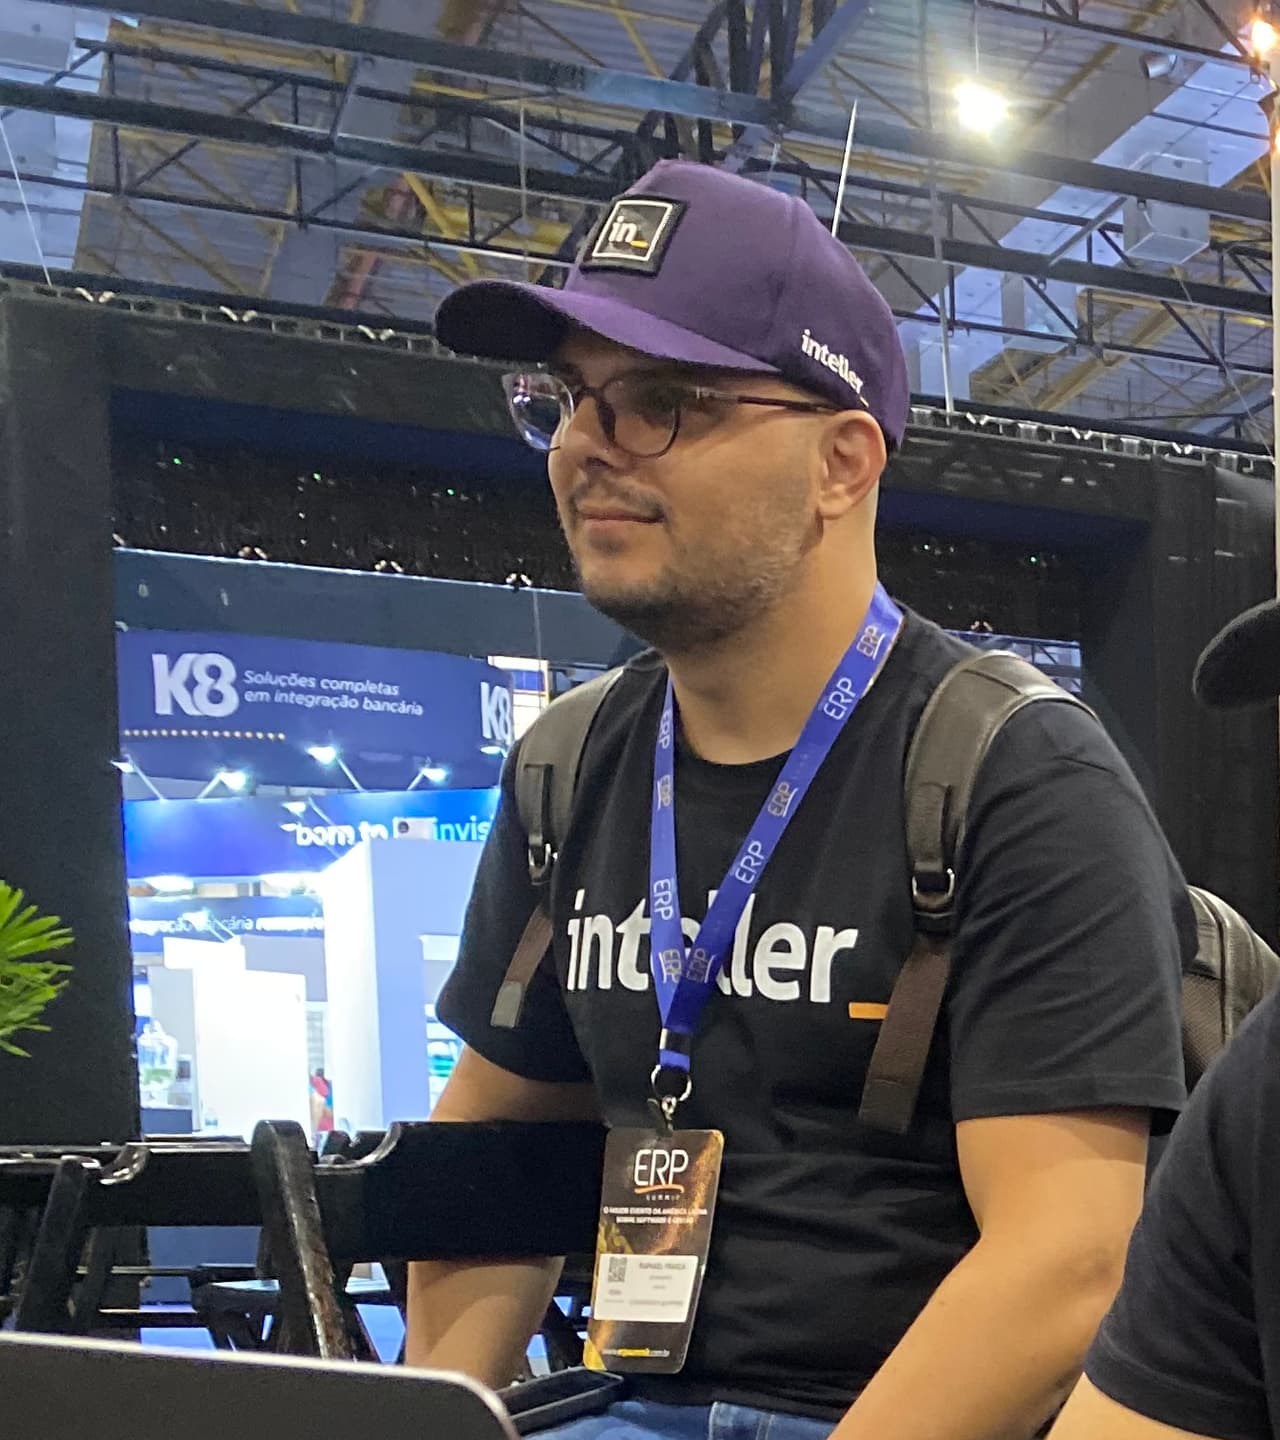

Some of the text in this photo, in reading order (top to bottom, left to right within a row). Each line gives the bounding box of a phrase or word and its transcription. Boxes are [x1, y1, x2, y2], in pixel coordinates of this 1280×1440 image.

[152, 652, 239, 718] K8
[243, 670, 400, 697] Soluções completas
[244, 689, 424, 716] em integração bancária
[823, 677, 857, 720] ERP
[480, 681, 512, 745] K8
[433, 814, 494, 841] invis
[735, 840, 765, 884] ERP
[653, 878, 673, 921] ERP
[634, 1149, 689, 1186] ERP
